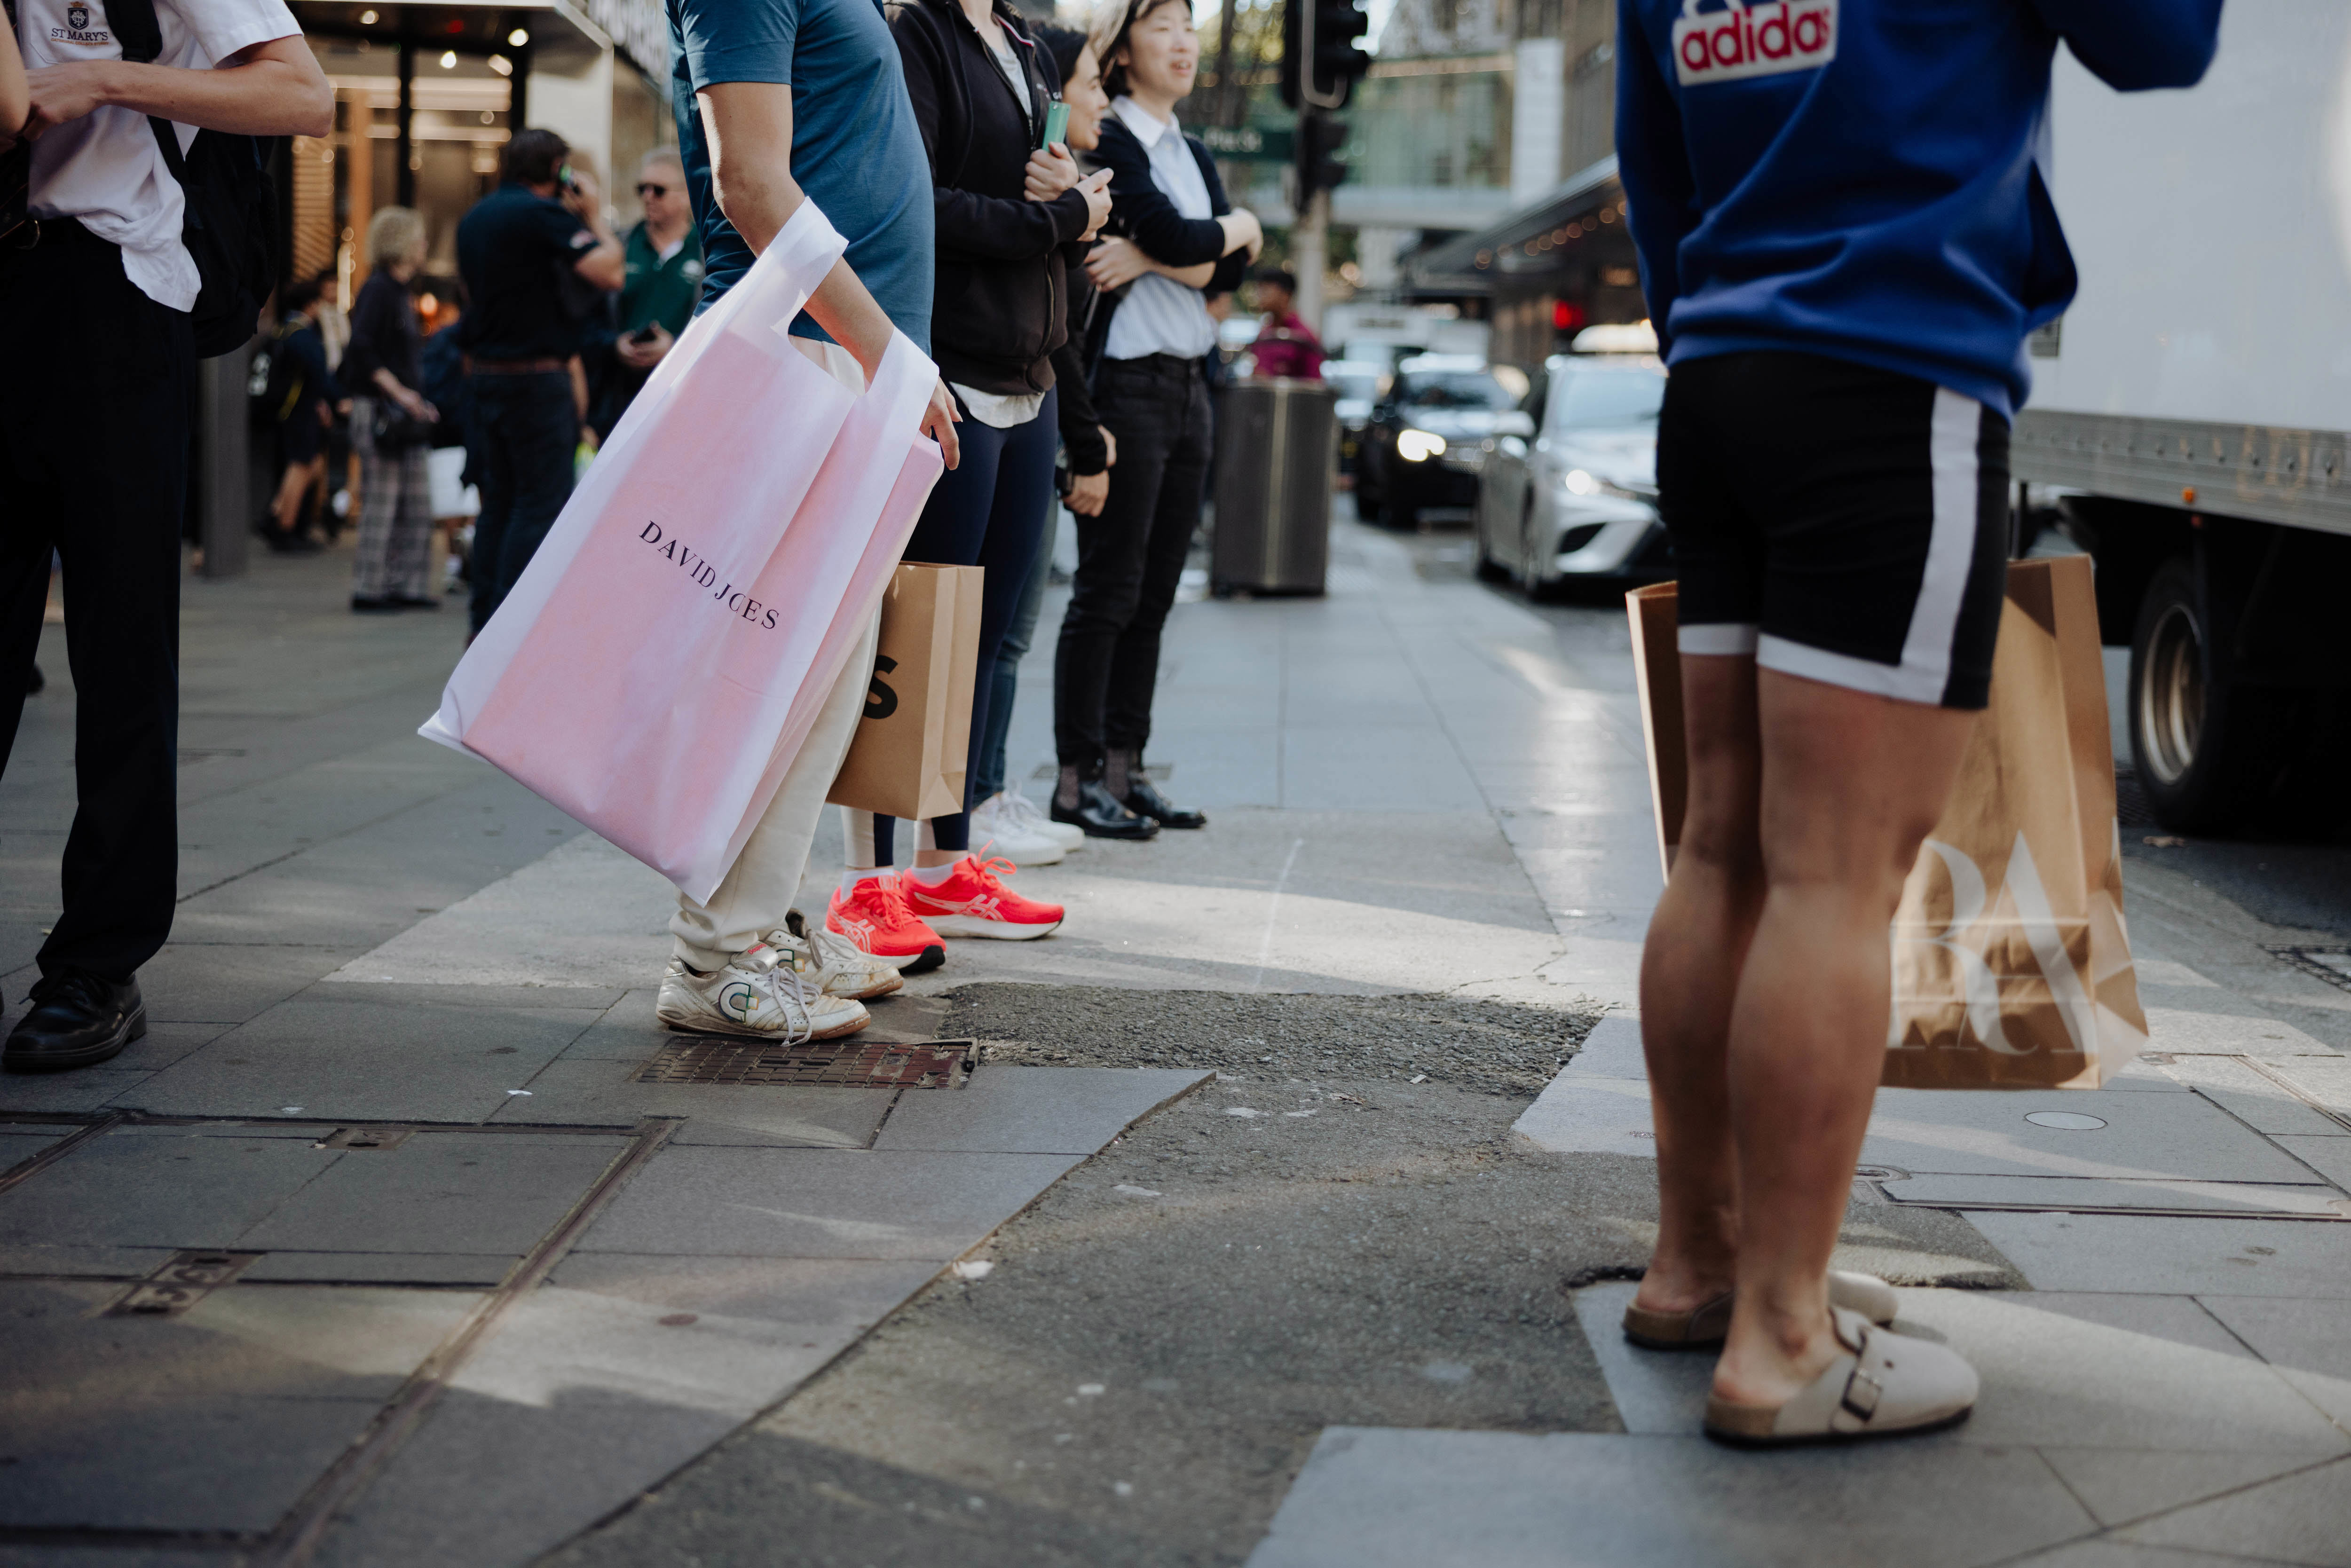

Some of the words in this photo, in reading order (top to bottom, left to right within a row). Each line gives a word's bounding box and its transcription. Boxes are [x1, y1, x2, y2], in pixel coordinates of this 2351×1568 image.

[52, 28, 65, 38] ST
[67, 30, 108, 41] MARY'S
[639, 520, 716, 588] DAVID
[714, 583, 780, 630] JOES
